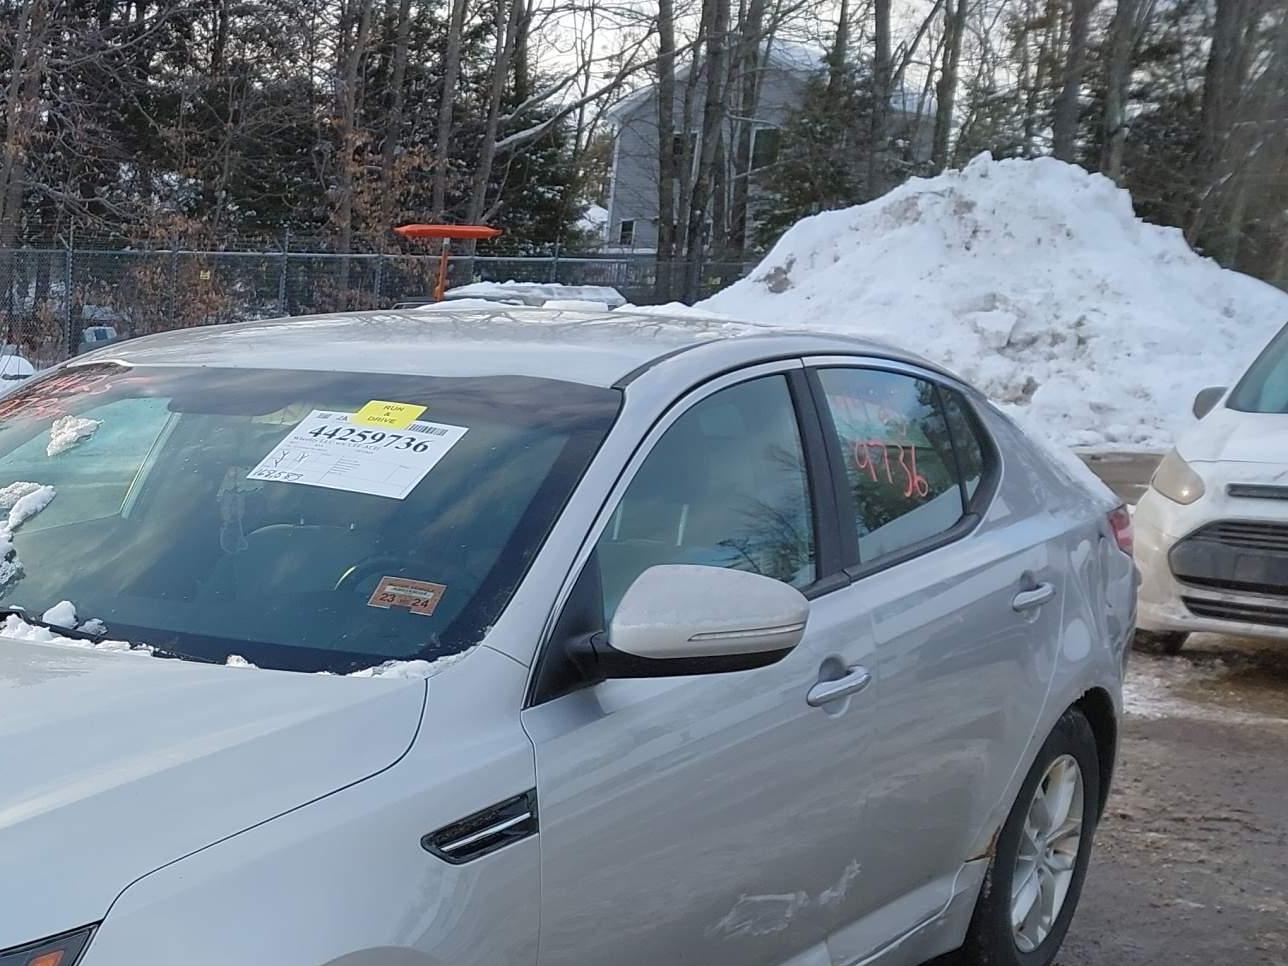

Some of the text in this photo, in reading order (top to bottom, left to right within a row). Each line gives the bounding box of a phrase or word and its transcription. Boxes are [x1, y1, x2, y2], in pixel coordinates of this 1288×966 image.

[383, 404, 405, 412] RUN
[367, 415, 397, 424] DRIVE
[309, 425, 432, 453] 44259736
[855, 438, 929, 497] 9736
[380, 592, 396, 603] 23
[412, 598, 429, 608] 24
